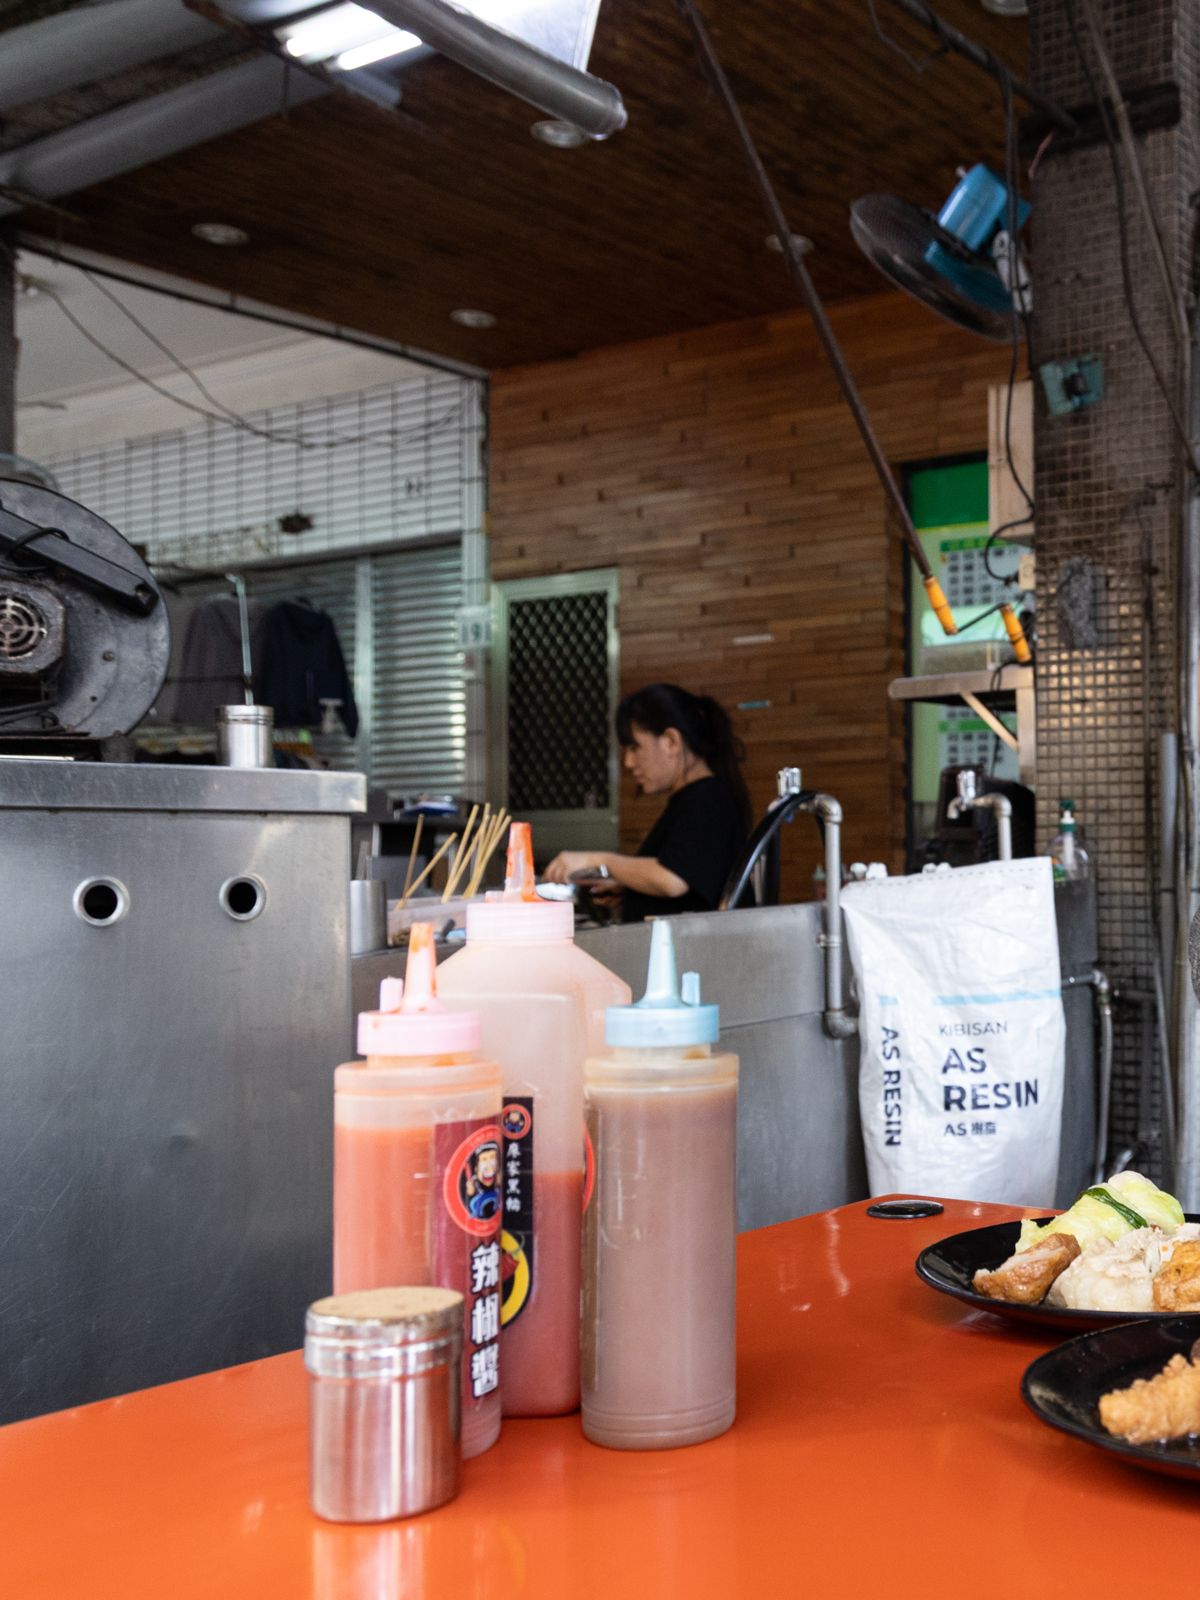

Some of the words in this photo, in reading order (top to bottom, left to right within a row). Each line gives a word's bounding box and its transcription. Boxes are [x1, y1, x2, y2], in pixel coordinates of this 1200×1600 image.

[881, 1026, 900, 1061] AS
[941, 1047, 988, 1075] AS
[883, 1069, 902, 1147] RESIN
[942, 1078, 1039, 1113] RESIN
[943, 1123, 967, 1137] AS
